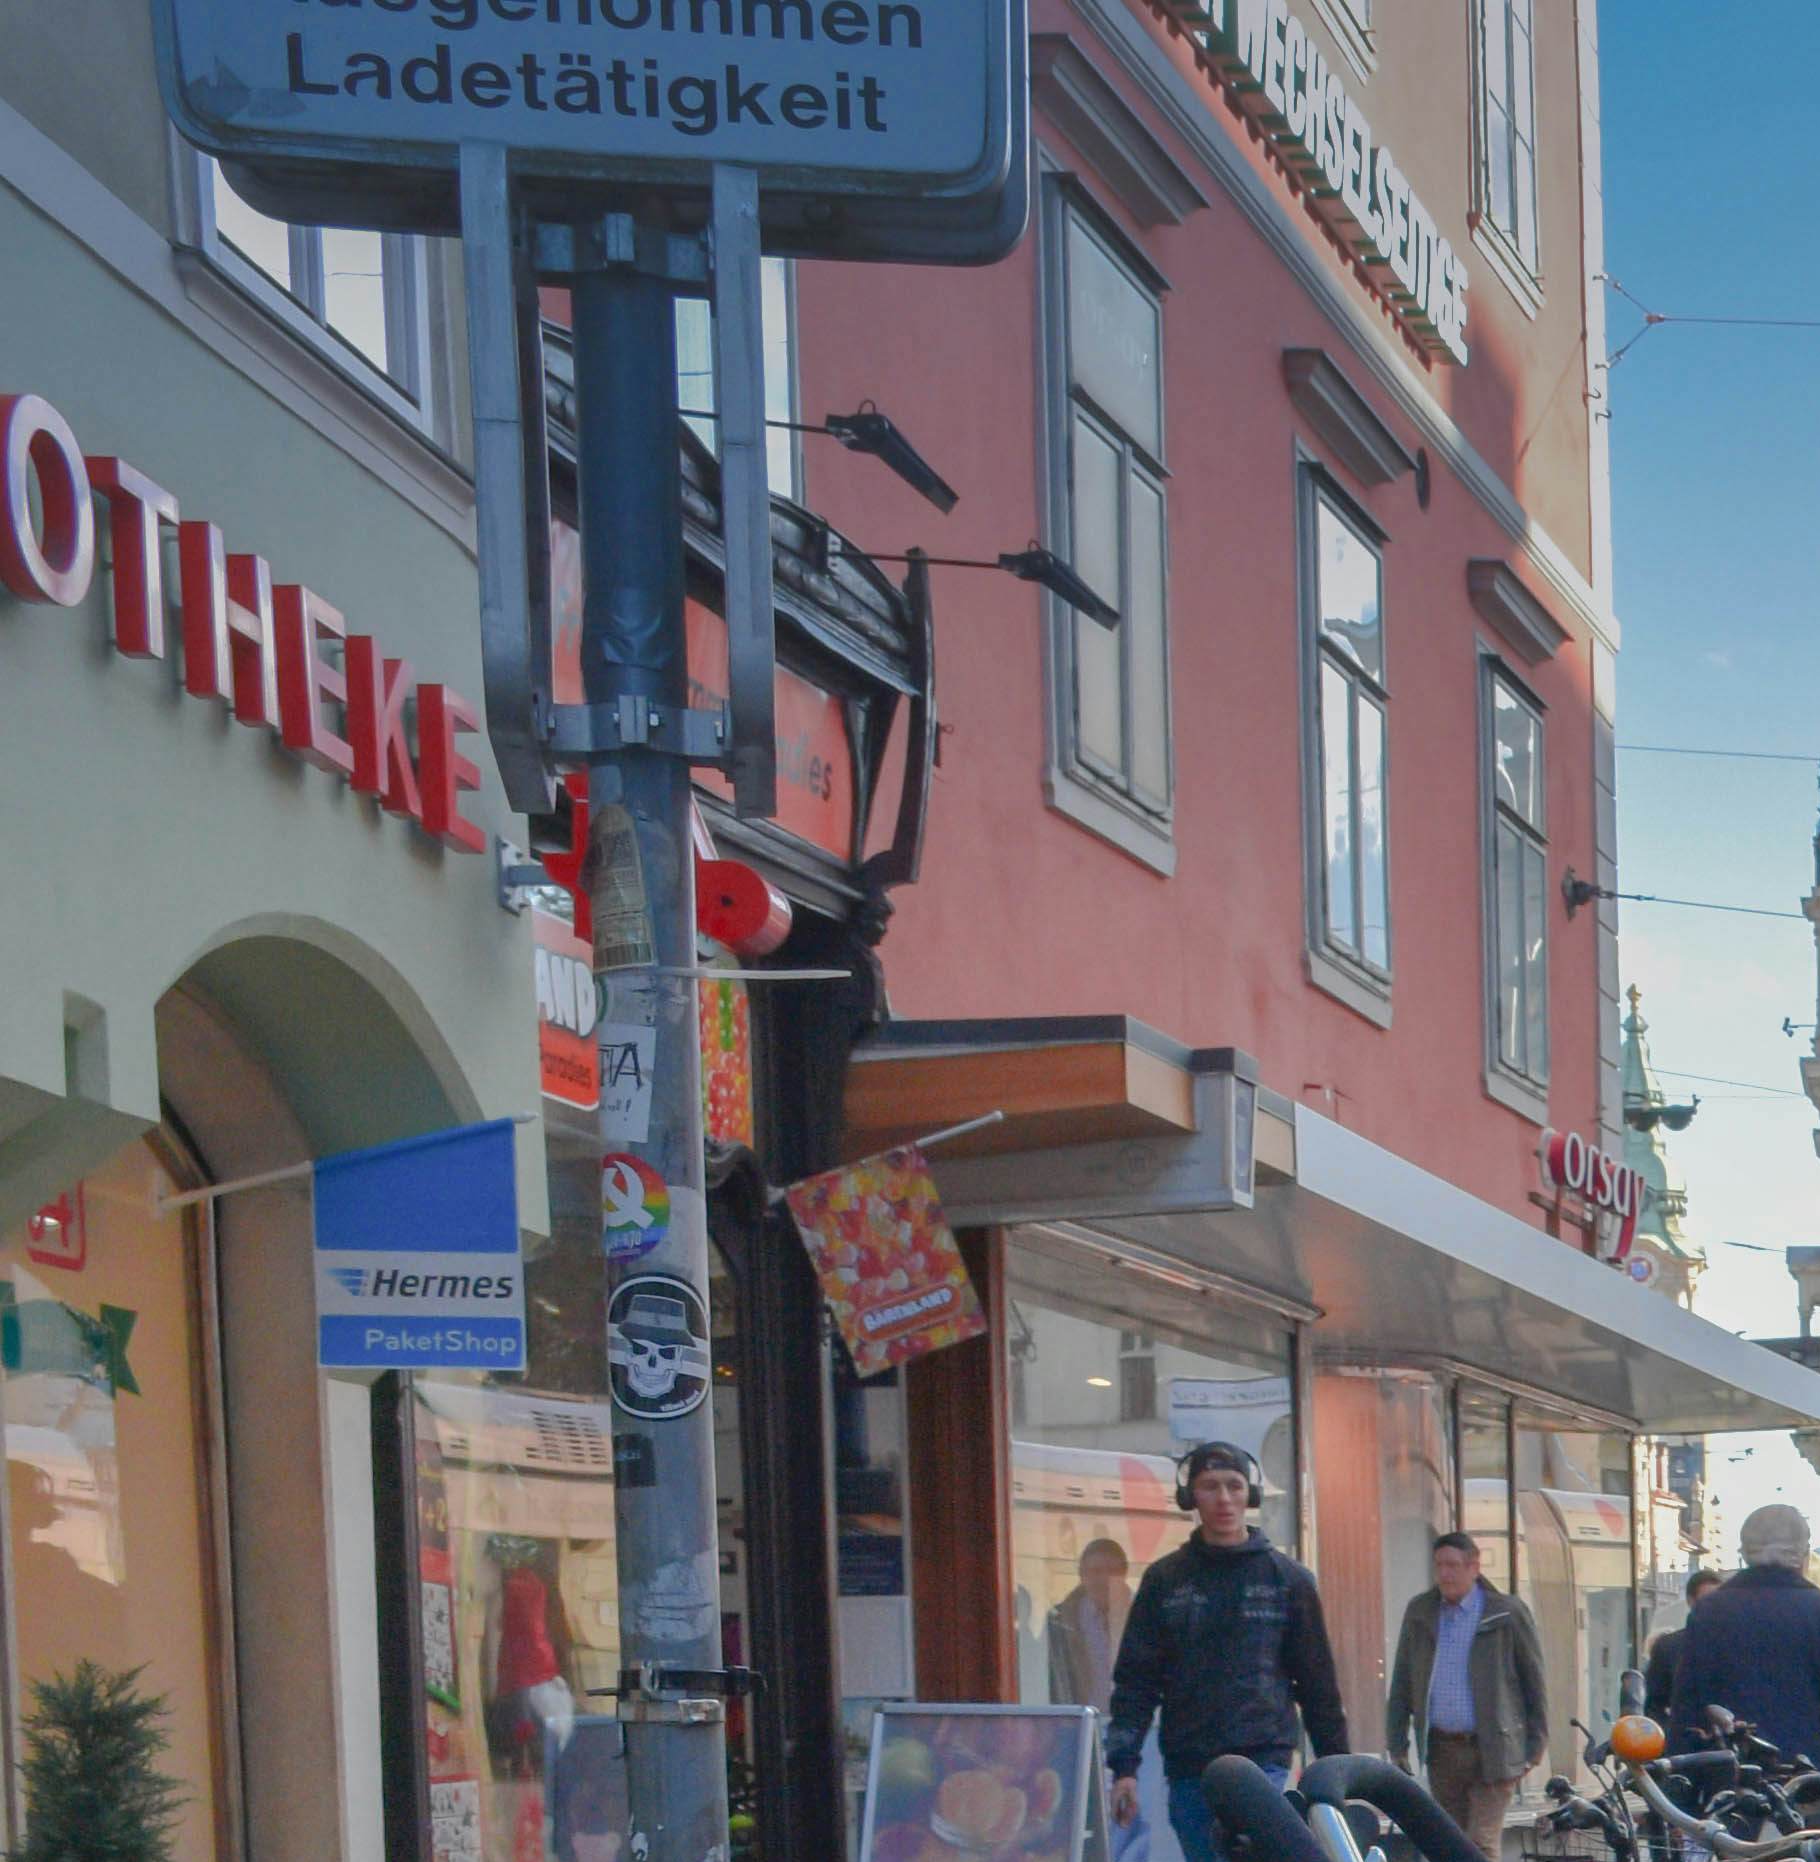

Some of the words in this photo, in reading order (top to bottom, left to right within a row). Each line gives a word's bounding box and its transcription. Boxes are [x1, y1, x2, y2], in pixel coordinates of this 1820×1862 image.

[286, 33, 888, 135] Ladetätigkeit
[371, 1266, 513, 1300] Hermes
[364, 1327, 517, 1358] PaketShop
